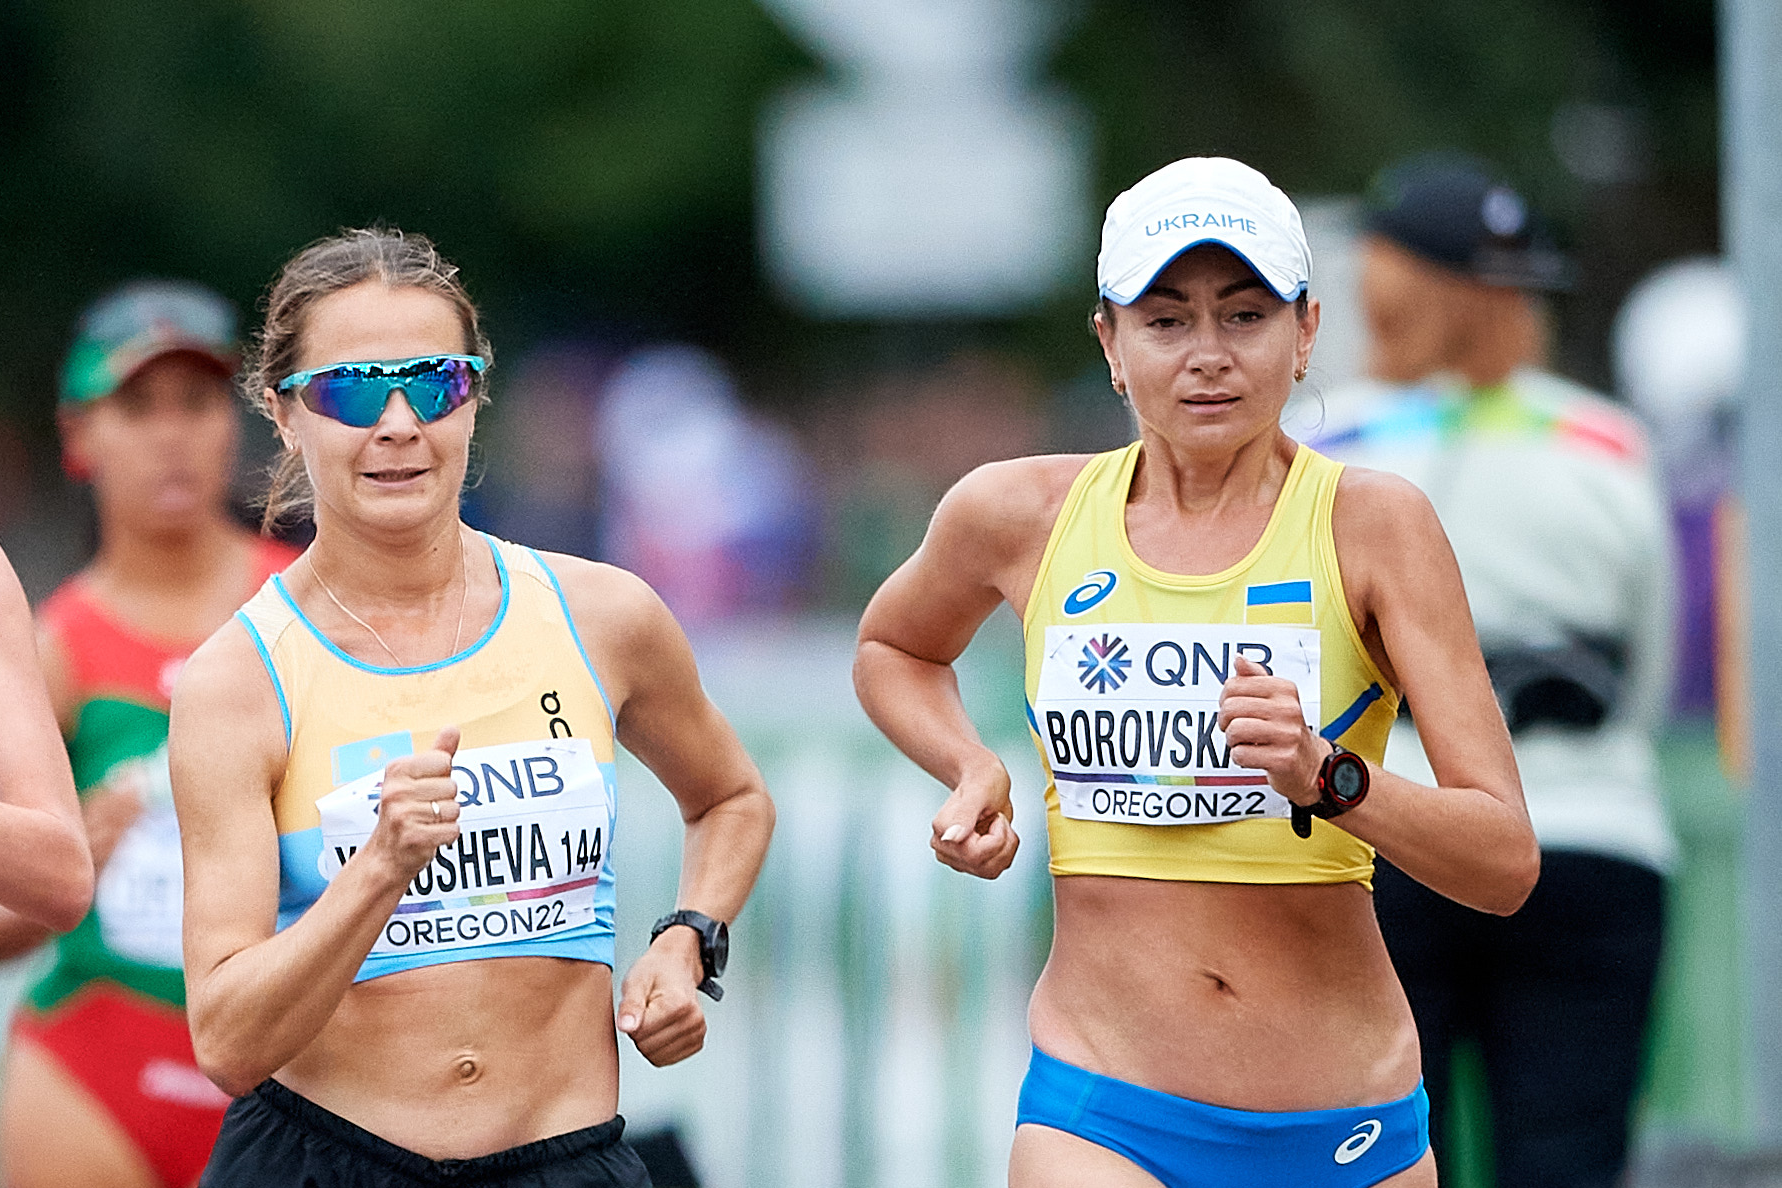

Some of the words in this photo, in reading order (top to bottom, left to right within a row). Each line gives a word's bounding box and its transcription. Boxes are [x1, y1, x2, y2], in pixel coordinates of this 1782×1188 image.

[1145, 641, 1273, 687] QNB
[451, 756, 564, 807] QNB
[1092, 788, 1266, 818] OREGON22
[561, 827, 601, 875] 144
[386, 900, 566, 946] OREGON22
